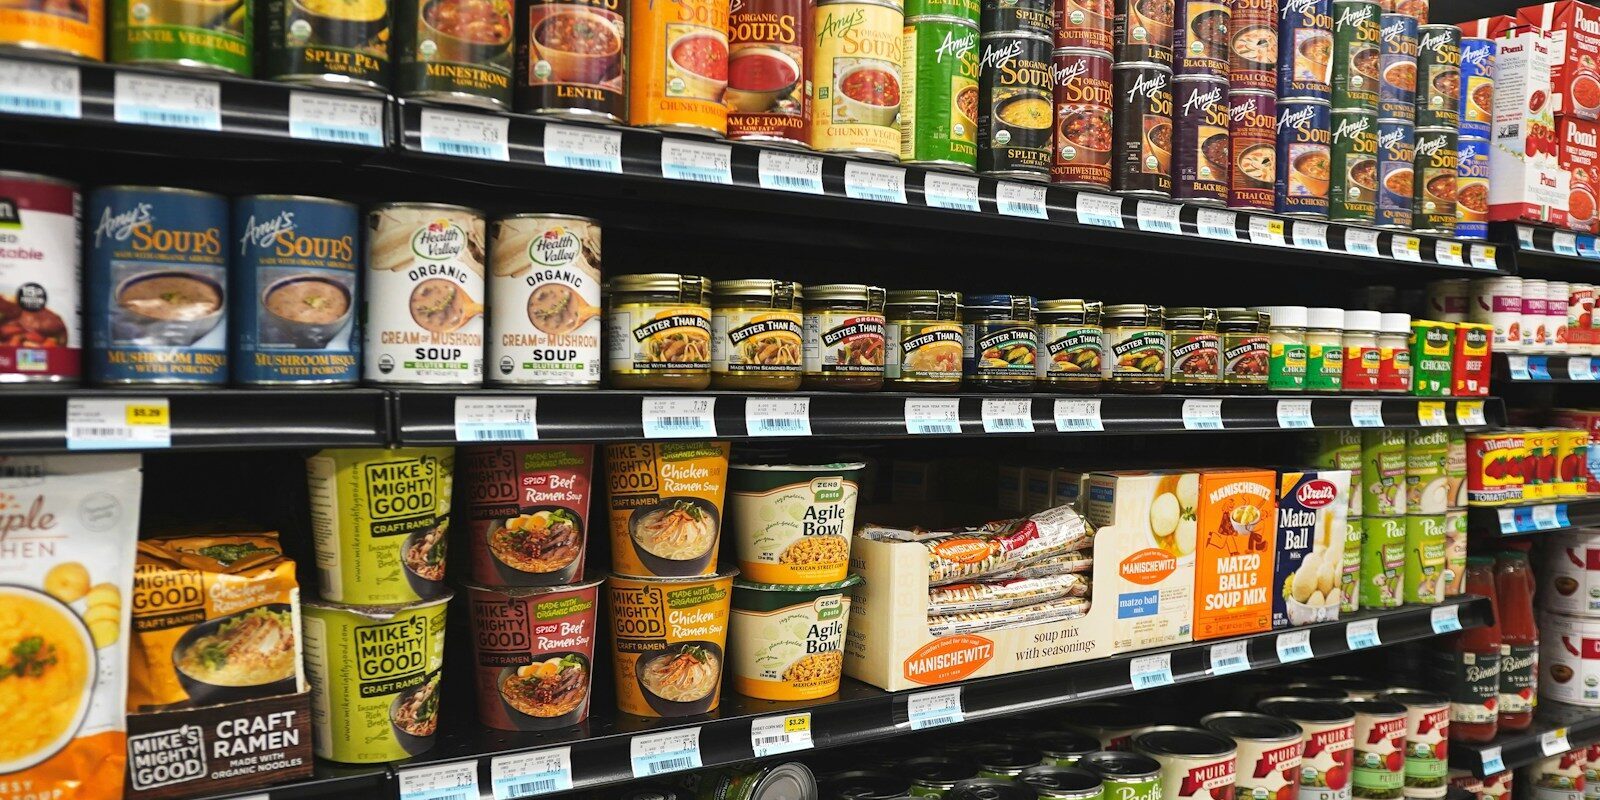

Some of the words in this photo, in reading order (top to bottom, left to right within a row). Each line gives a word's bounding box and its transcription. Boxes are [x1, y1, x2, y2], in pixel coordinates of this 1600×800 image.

[739, 14, 778, 23] ORGANIC
[1016, 10, 1043, 22] SPLIT
[1336, 5, 1374, 31] Amy's
[819, 9, 866, 48] Amy's
[128, 30, 174, 43] LENTIL
[179, 31, 247, 57] VEGETABLE
[843, 29, 901, 63] SOUPS
[935, 31, 978, 63] Amy's
[1416, 30, 1453, 57] Amy's
[1501, 45, 1524, 55] Pomi
[305, 48, 351, 66] SPLIT
[354, 52, 380, 72] PEA
[980, 40, 1024, 77] Amy's
[1461, 44, 1492, 64] Amy's
[1018, 60, 1048, 71] ORGANIC
[1184, 60, 1207, 69] BLACK
[427, 63, 508, 89] MINESTRONE
[1230, 74, 1253, 82] THAI
[1292, 81, 1304, 89] NO
[557, 85, 605, 101] LENTIL
[1127, 73, 1167, 104] Amy's
[660, 100, 698, 112] CHUNKY
[1183, 87, 1221, 117] Amy's
[747, 117, 760, 126] OF
[762, 117, 803, 129] TOMATO
[1277, 106, 1315, 134] Amy's
[827, 126, 870, 137] CHUNKY
[1332, 117, 1369, 146] Amy's
[1567, 122, 1597, 148] Pomi
[1007, 148, 1037, 160] SPLIT
[1414, 135, 1448, 159] Amy's
[806, 162, 819, 175] 5.19
[1193, 183, 1215, 191] BLACK
[1540, 172, 1557, 188] Pomi
[1235, 191, 1258, 200] THAI
[1286, 196, 1299, 206] NO
[95, 202, 155, 248] Amy's
[240, 210, 296, 256] Amy's
[132, 223, 222, 256] SOUPS
[276, 230, 353, 263] SOUPS
[421, 230, 458, 245] Health
[536, 238, 573, 251] Health
[428, 243, 460, 257] Valley
[545, 249, 575, 263] Valley
[408, 264, 468, 284] ORGANIC
[526, 270, 583, 289] ORGANIC
[635, 321, 671, 340] BETTER
[672, 316, 696, 327] THAN
[731, 324, 765, 343] BETTER
[767, 320, 789, 331] THAN
[824, 327, 857, 344] BETTER
[859, 324, 877, 334] THAN
[381, 331, 421, 345] CREAM
[431, 332, 482, 348] MUSHROOM
[502, 334, 537, 348] CREAM
[547, 334, 598, 349] MUSHROOM
[903, 335, 934, 352] BETTER
[935, 331, 955, 341] THAN
[980, 334, 1010, 351] BETTER
[1010, 330, 1029, 341] THAN
[1050, 339, 1078, 355] BETTER
[1080, 334, 1097, 344] THAN
[1115, 339, 1143, 354] BETTER
[1144, 337, 1160, 347] THAN
[1174, 343, 1200, 358] BETTER
[1200, 339, 1214, 349] THAN
[108, 350, 194, 366] MUSHROOM
[415, 348, 461, 361] SOUP
[533, 349, 577, 361] SOUP
[1226, 345, 1252, 360] BETTER
[1253, 342, 1266, 351] THAN
[255, 354, 329, 368] MUSHROOM
[1420, 360, 1451, 371] CHICKEN
[1465, 360, 1483, 371] BEEF
[693, 399, 708, 411] 7.79
[793, 402, 806, 413] 7.79
[370, 455, 433, 485] MIKE'S
[661, 463, 709, 480] Chicken
[373, 477, 434, 500] MIGHTY
[523, 475, 546, 486] SPICY
[549, 473, 576, 489] Beef
[663, 479, 702, 493] Ramen
[703, 483, 720, 496] Soup
[526, 487, 565, 503] Ramen
[566, 491, 583, 504] Soup
[630, 497, 658, 506] RAMEN
[820, 491, 840, 502] pasta
[1209, 482, 1272, 504] MANISCHEWITZ
[374, 492, 433, 516] GOOD
[803, 504, 845, 524] Agile
[1280, 507, 1316, 529] Matzo
[373, 522, 405, 534] CRAFT
[406, 516, 435, 530] RAMEN
[803, 521, 844, 538] Bowl
[1284, 528, 1309, 551] Ball
[1122, 556, 1176, 576] MANISCHEWITZ
[1216, 553, 1261, 571] MATZO
[134, 572, 197, 590] MIGHTY
[1219, 574, 1250, 592] BALL
[132, 586, 199, 609] GOOD
[613, 587, 658, 606] MIKE'S
[1119, 597, 1144, 608] matzo
[1143, 594, 1158, 605] ball
[1204, 594, 1240, 612] SOUP
[1243, 590, 1267, 606] MIX
[614, 607, 660, 620] MIGHTY
[669, 609, 714, 625] Chicken
[822, 609, 840, 619] pasta
[1133, 606, 1145, 614] mix
[360, 615, 424, 644] MIKE'S
[535, 624, 558, 635] SPICY
[559, 622, 584, 637] Beef
[616, 620, 662, 639] GOOD
[672, 625, 708, 639] Ramen
[708, 625, 723, 638] Soup
[806, 622, 843, 642] Agile
[1033, 630, 1057, 643] soup
[1062, 626, 1080, 638] mix
[362, 636, 423, 659] MIGHTY
[538, 634, 575, 651] Ramen
[576, 635, 590, 648] Soup
[618, 643, 637, 651] CRAFT
[637, 642, 665, 651] RAMEN
[806, 639, 842, 655] Bowl
[1016, 648, 1040, 662] with
[1041, 639, 1096, 660] seasonings
[363, 651, 423, 676] GOOD
[500, 654, 530, 664] RAMEN
[908, 643, 992, 677] MANISCHEWITZ
[362, 682, 395, 694] CRAFT
[396, 675, 425, 690] RAMEN
[216, 710, 296, 740] CRAFT
[788, 717, 805, 726] $3.29
[1378, 719, 1404, 735] MUIR
[132, 724, 199, 754] MIKE'S
[213, 729, 300, 759] RAMEN
[1316, 730, 1346, 747] MUIR
[135, 744, 201, 769] MIGHTY
[230, 756, 257, 768] MADE
[259, 752, 285, 764] WITH
[1267, 749, 1297, 766] MUIR
[138, 760, 200, 788] GOOD
[211, 766, 255, 781] ORGANIC
[257, 757, 303, 774] NOODLES
[1194, 763, 1227, 784] MUIR
